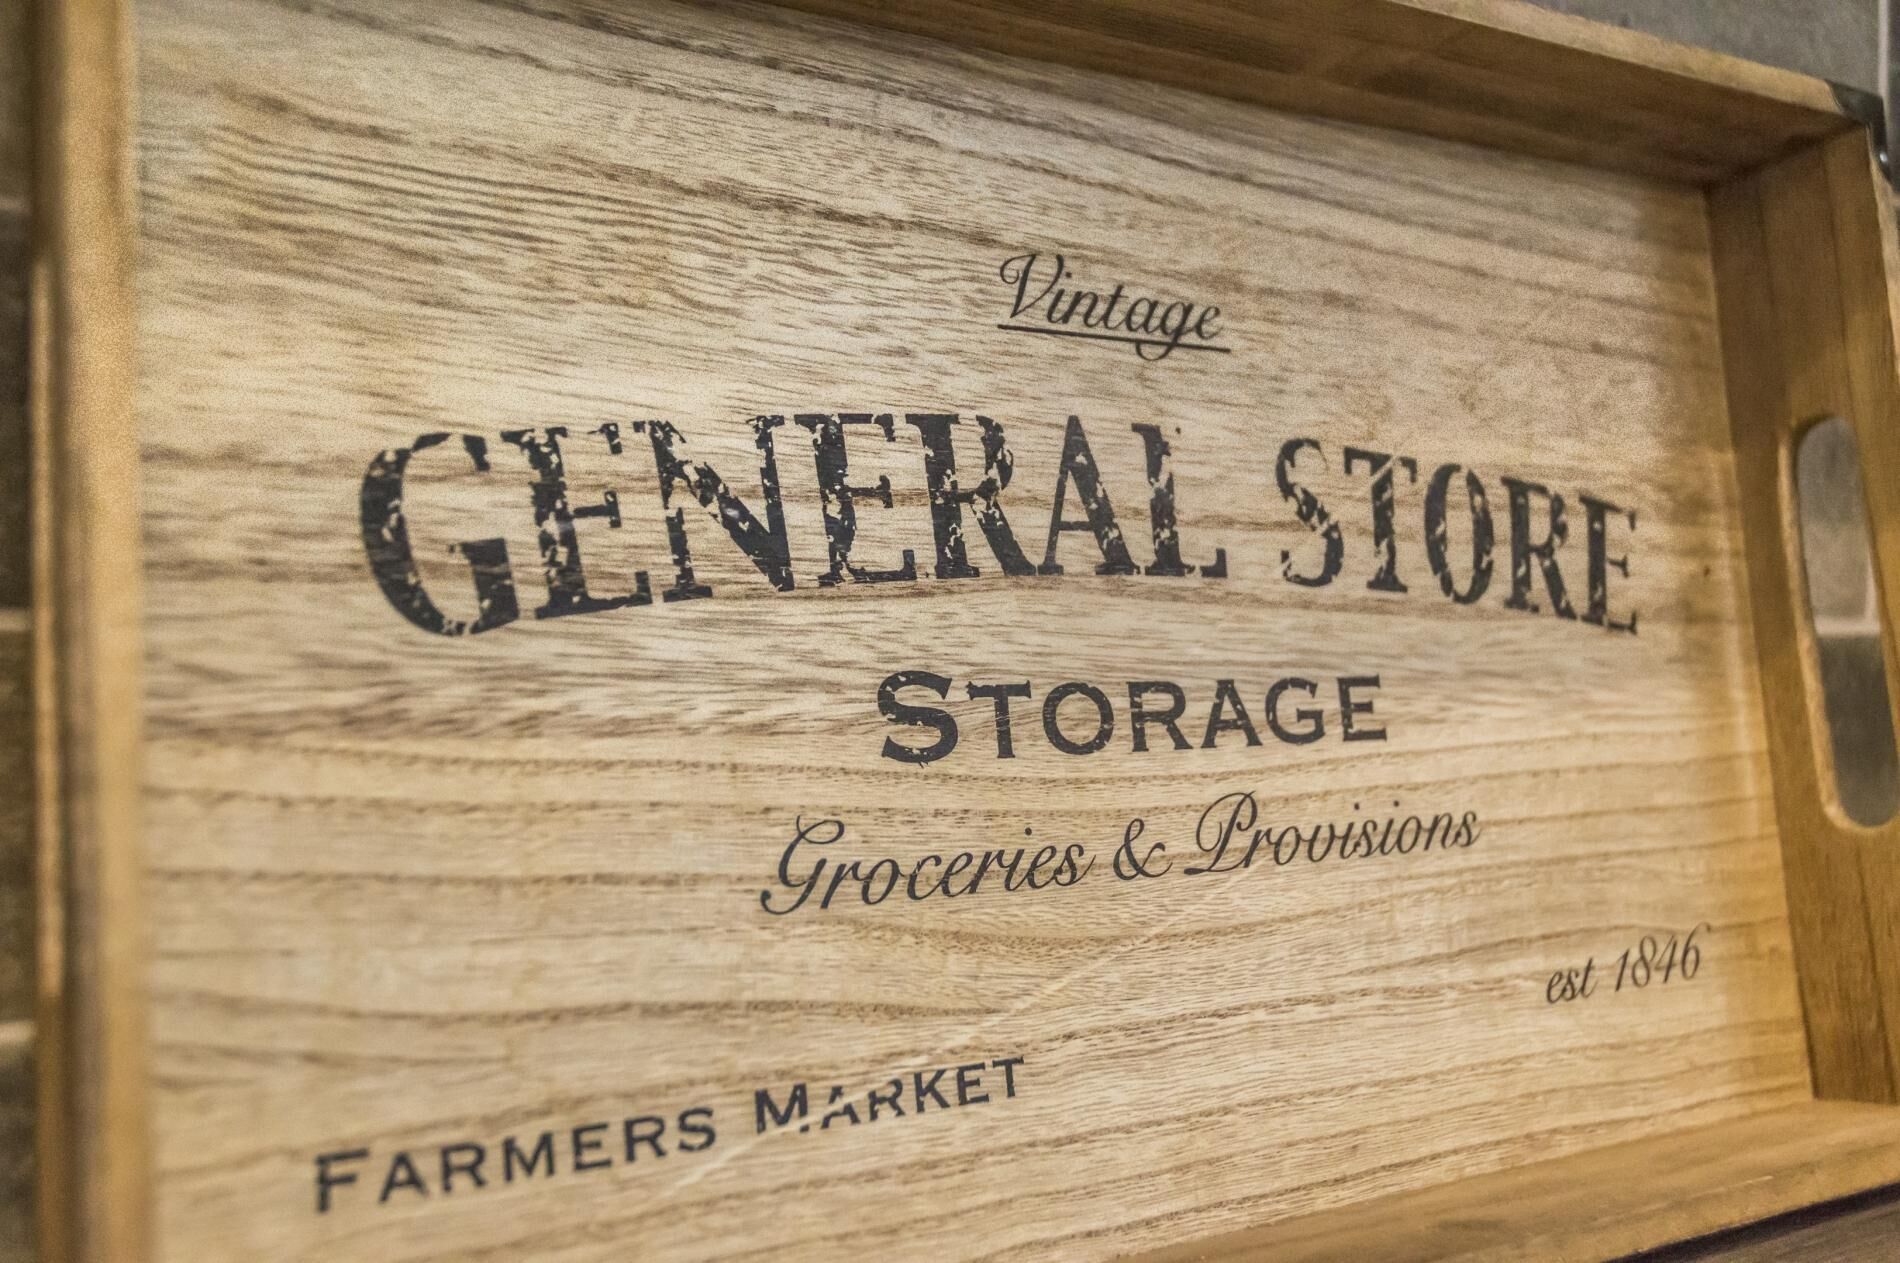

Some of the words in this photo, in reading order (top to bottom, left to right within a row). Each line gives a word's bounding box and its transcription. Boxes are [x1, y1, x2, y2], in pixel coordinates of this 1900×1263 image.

[998, 253, 1231, 361] Vintage
[360, 413, 1228, 637] GENERAL
[1276, 437, 1639, 635] STORE
[877, 670, 1388, 768] STORAGE
[760, 814, 1095, 915] Groceries
[1112, 818, 1173, 881] &
[1184, 790, 1482, 876] Provisions
[1546, 956, 1597, 1004] est
[1614, 923, 1712, 993] 1846
[316, 1107, 717, 1213] FARMERS
[754, 1055, 1026, 1134] MARKET
